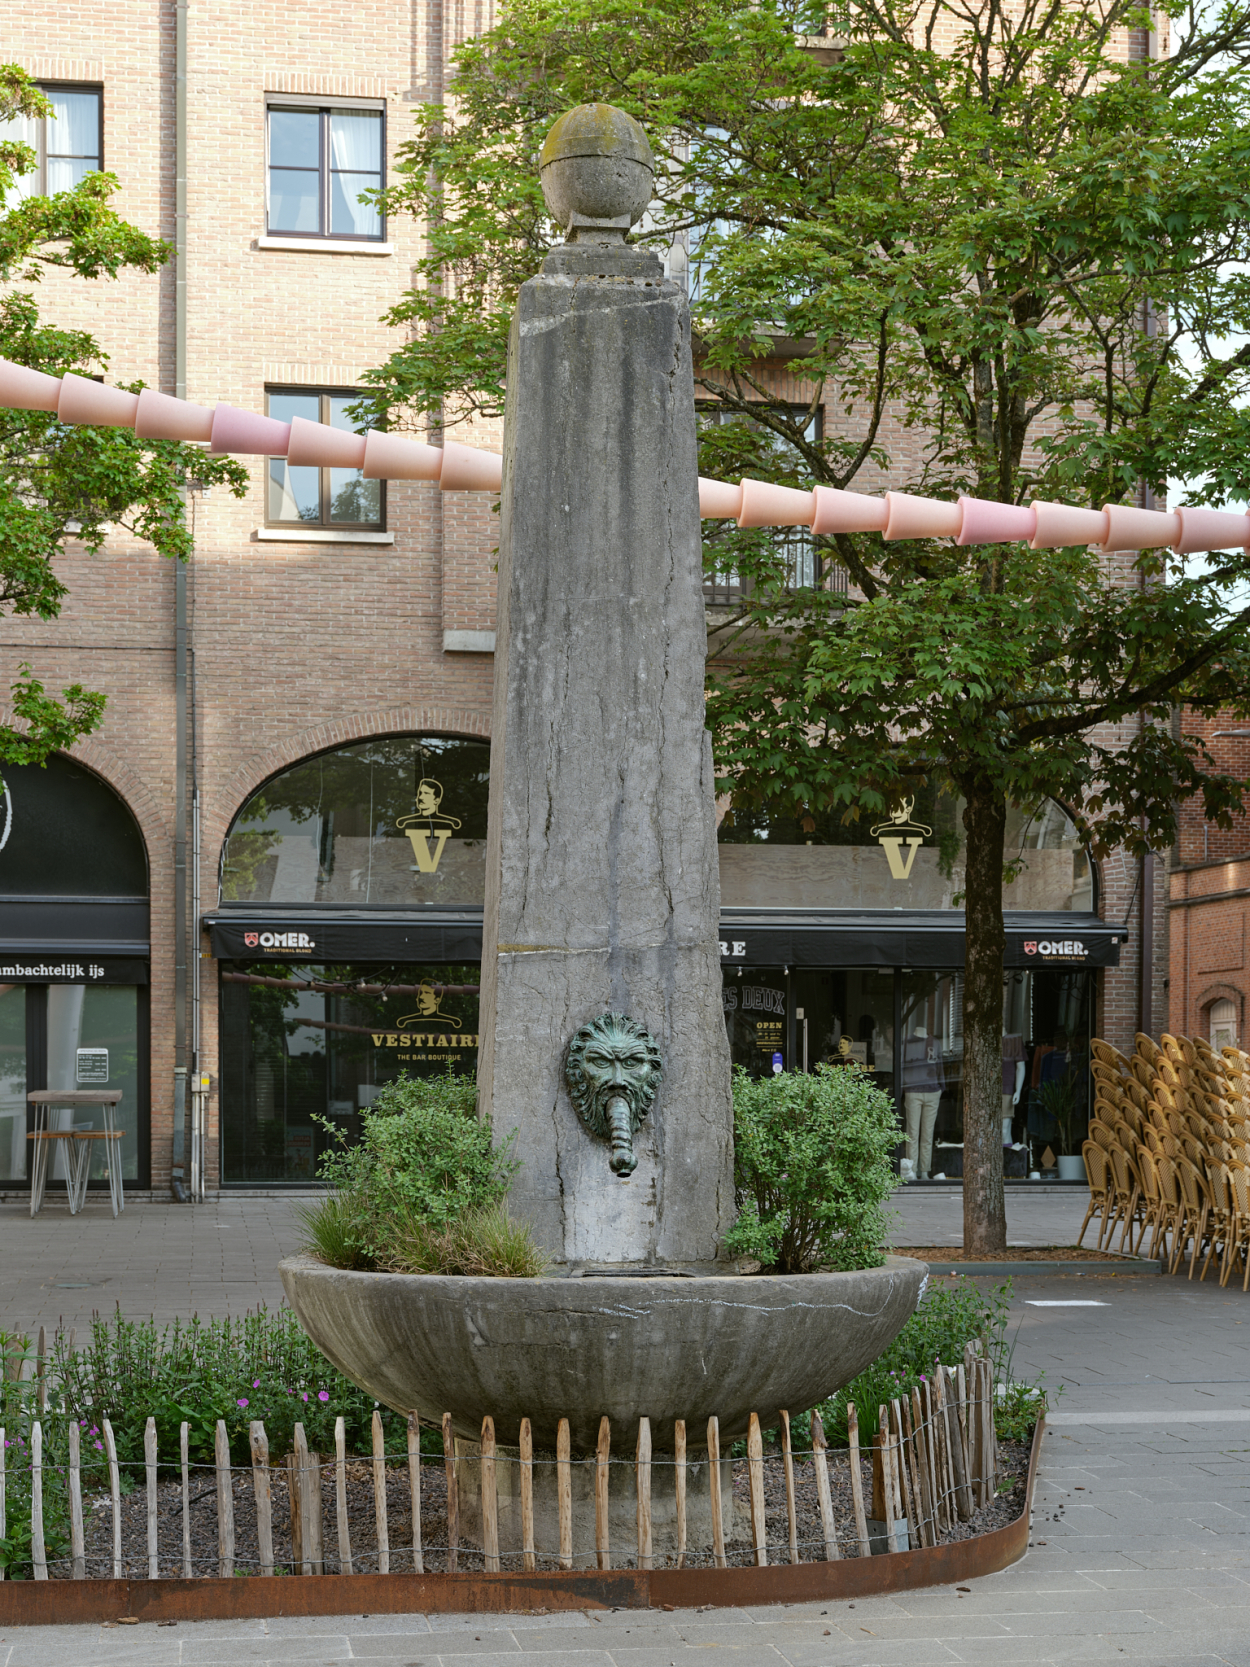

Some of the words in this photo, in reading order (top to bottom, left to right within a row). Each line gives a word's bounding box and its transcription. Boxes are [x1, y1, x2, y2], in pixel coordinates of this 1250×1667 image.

[405, 829, 452, 873] V
[878, 836, 923, 879] V
[259, 932, 315, 948] OMER.
[1038, 941, 1089, 955] OMER.
[88, 964, 105, 979] ijs
[742, 985, 785, 1015] DEUX
